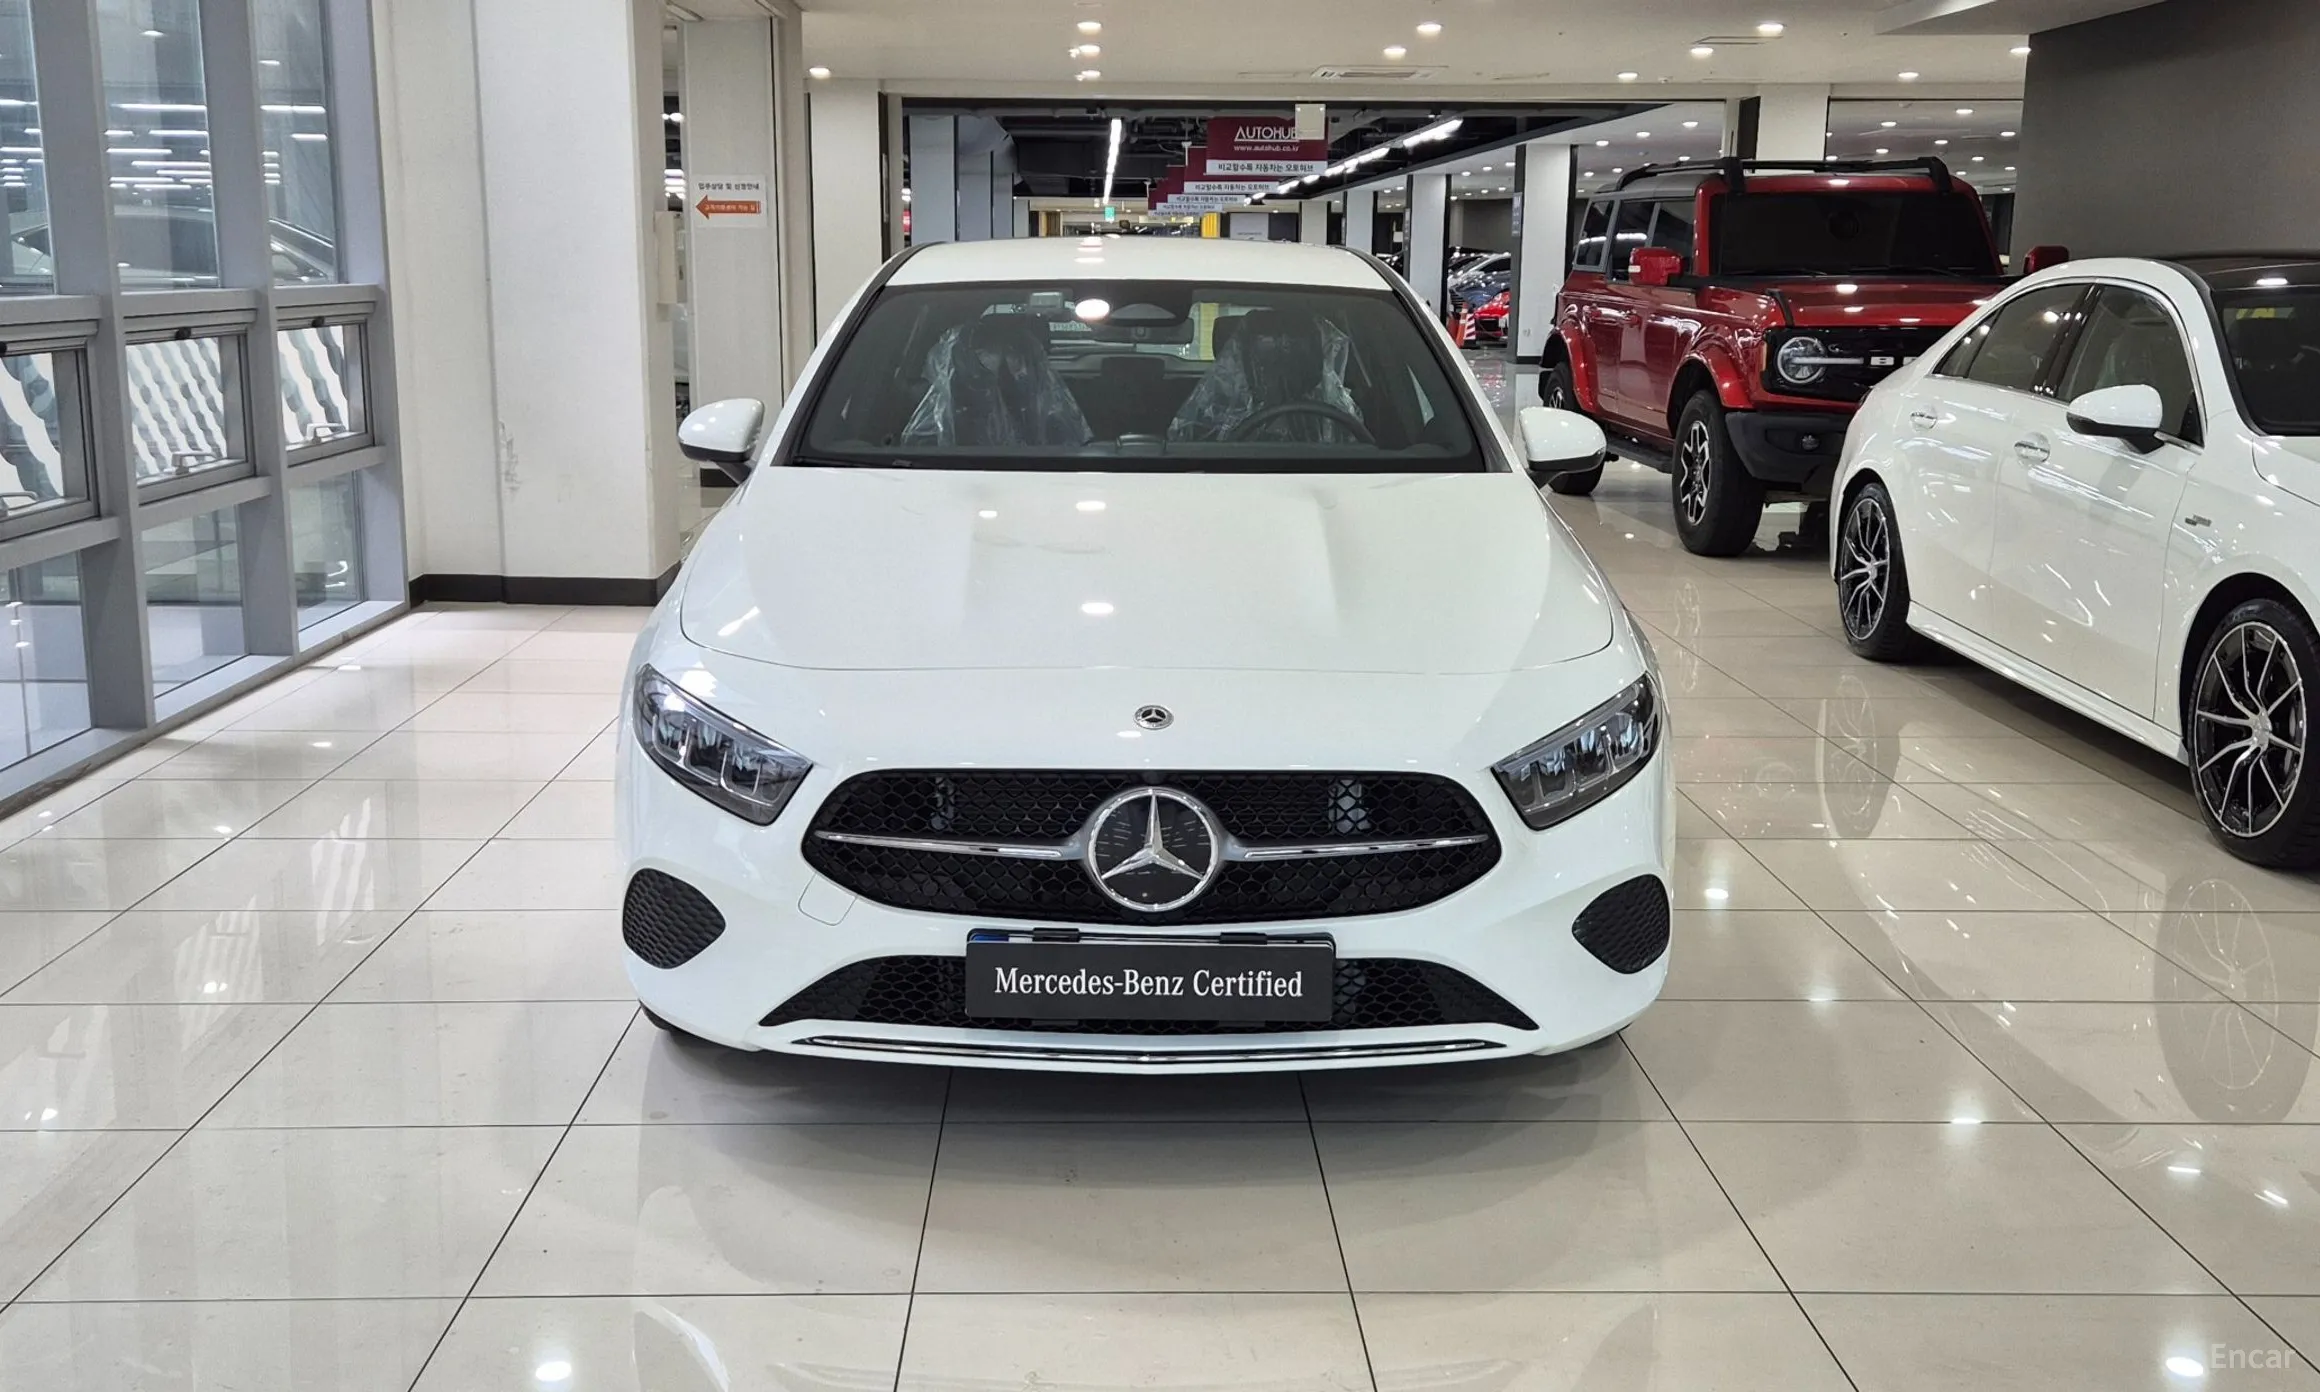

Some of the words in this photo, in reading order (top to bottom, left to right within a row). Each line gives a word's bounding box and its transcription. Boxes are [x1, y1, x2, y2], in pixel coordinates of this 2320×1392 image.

[1218, 163, 1253, 172] 비교할수록
[1255, 163, 1284, 173] 자동차는
[1285, 163, 1314, 172] 오토허브
[994, 967, 1184, 996] Mercedes-Benz
[1193, 969, 1303, 997] Certified
